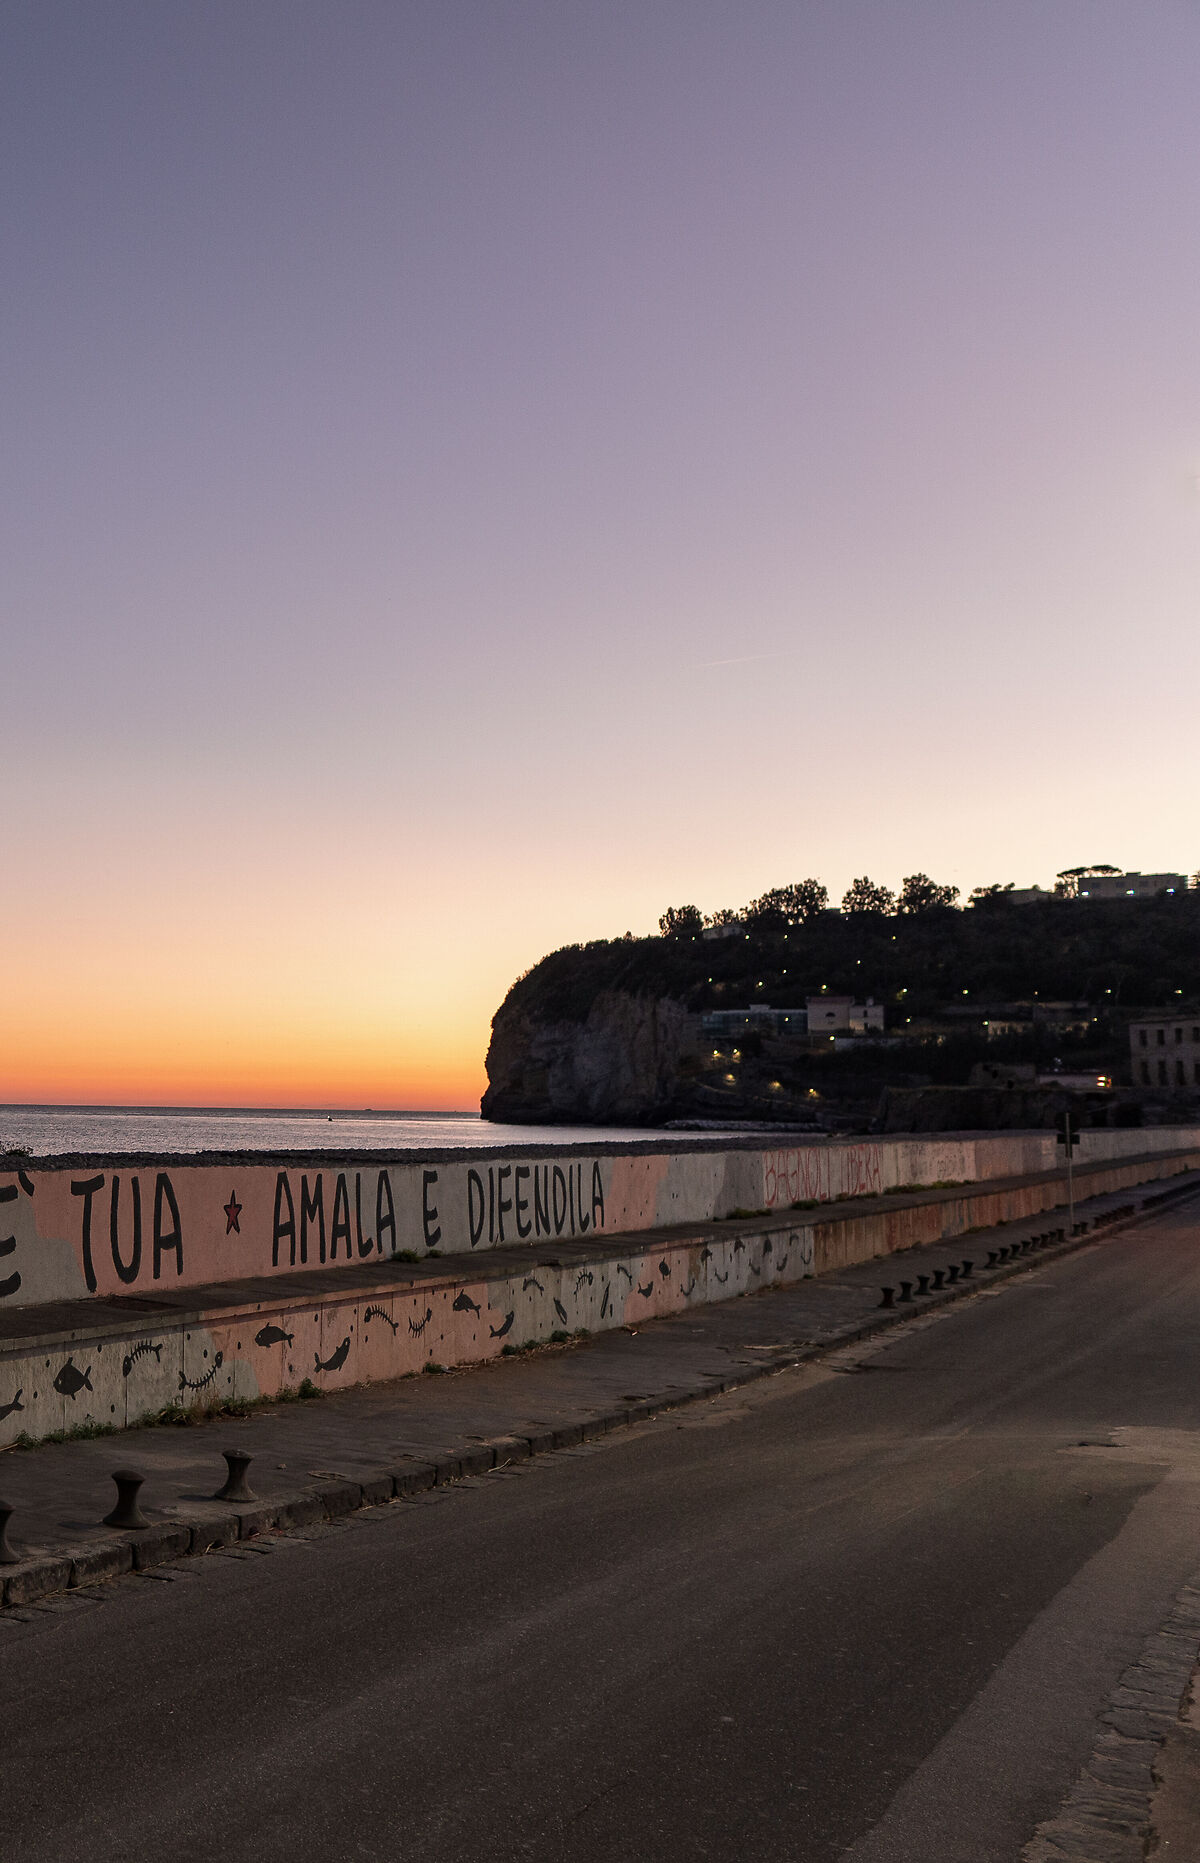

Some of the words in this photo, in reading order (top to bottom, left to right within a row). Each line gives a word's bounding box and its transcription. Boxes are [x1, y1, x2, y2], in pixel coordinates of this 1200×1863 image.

[70, 1172, 184, 1293] TUA
[272, 1170, 397, 1267] AMALA
[422, 1169, 442, 1248] E
[467, 1160, 605, 1248] DIFENDILA
